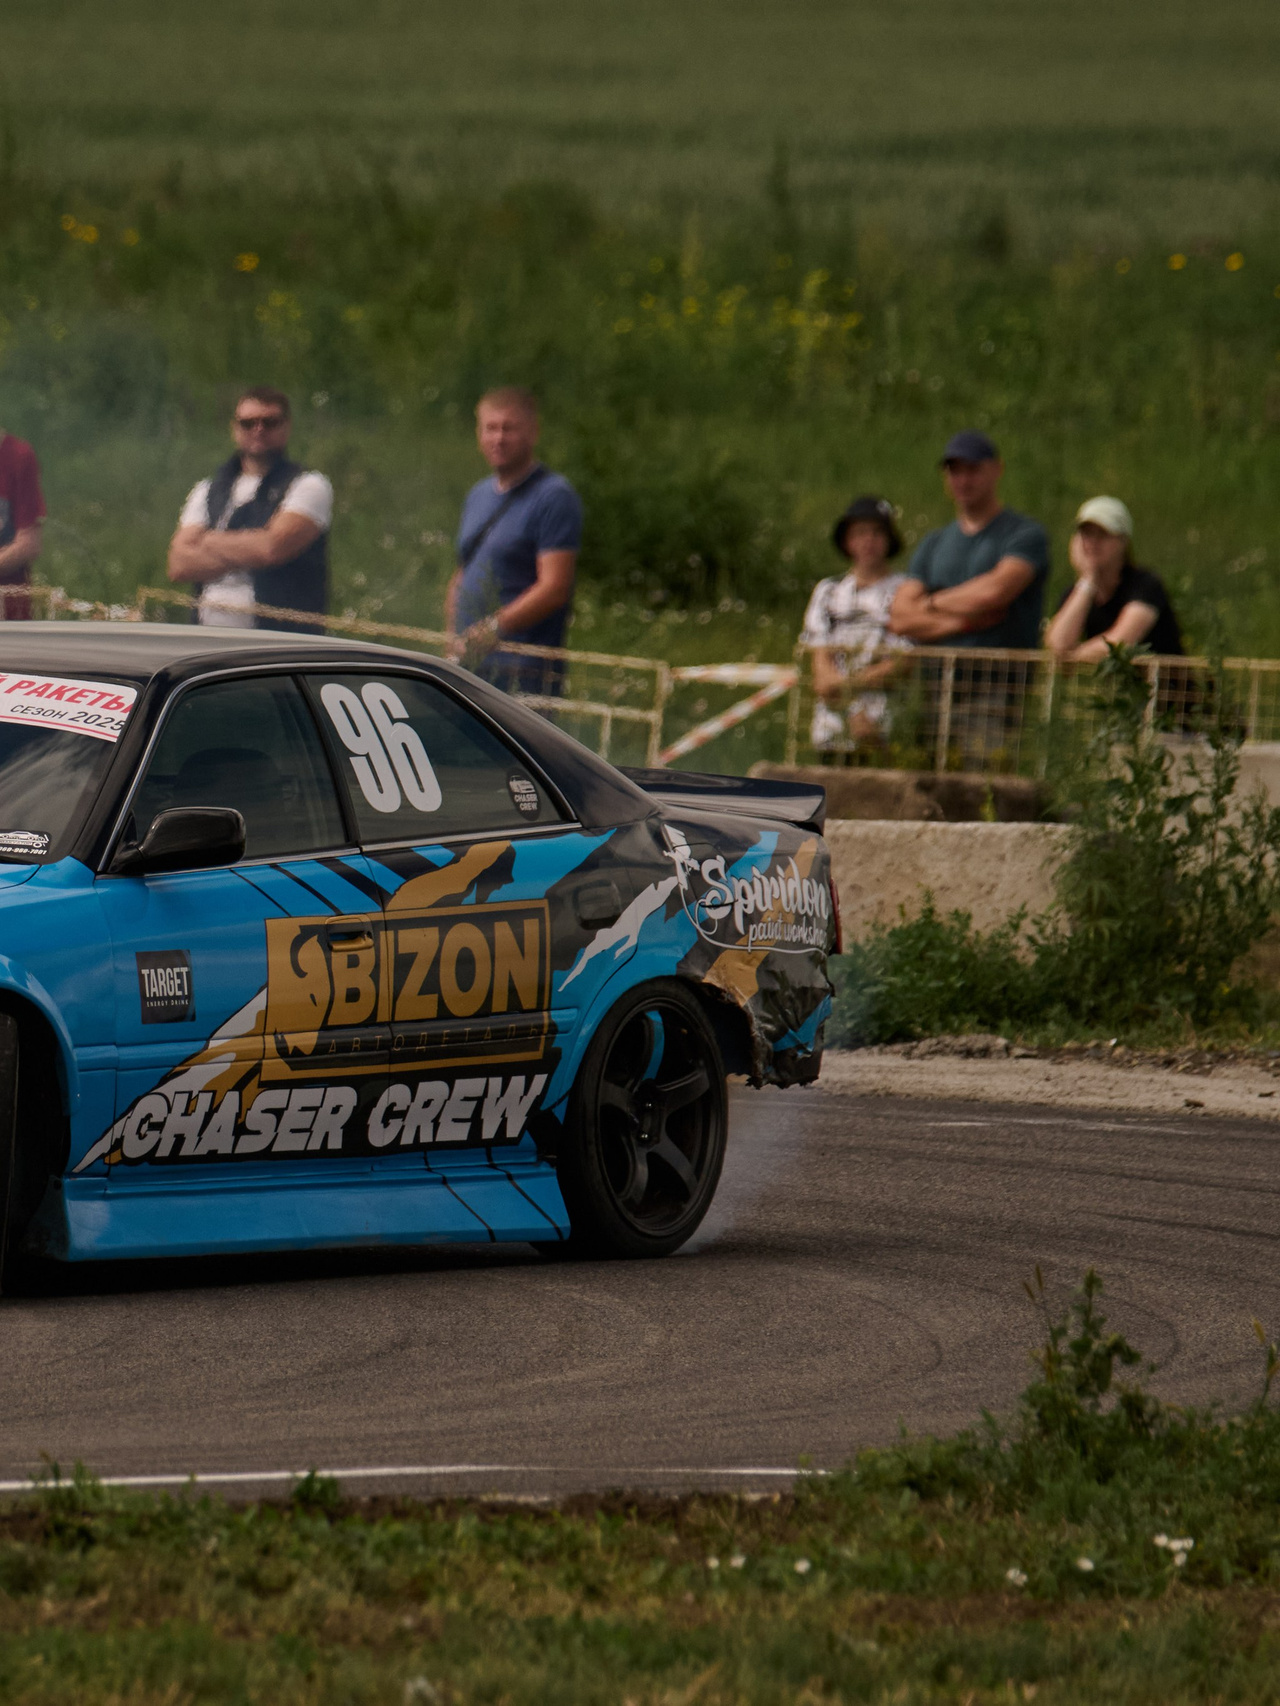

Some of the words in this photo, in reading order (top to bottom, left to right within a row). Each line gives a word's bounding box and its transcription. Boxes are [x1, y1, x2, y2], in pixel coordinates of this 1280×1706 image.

[4, 680, 133, 713] РАКЕТЫ
[10, 704, 68, 719] СЕЗОН
[68, 711, 126, 731] 2025
[320, 682, 442, 813] 96
[701, 855, 829, 935] Spiridon
[747, 912, 782, 953] paint
[141, 967, 189, 998] TARGET
[327, 918, 540, 1026] BIZON
[121, 1085, 358, 1160] CHASER
[367, 1074, 548, 1148] CREW
